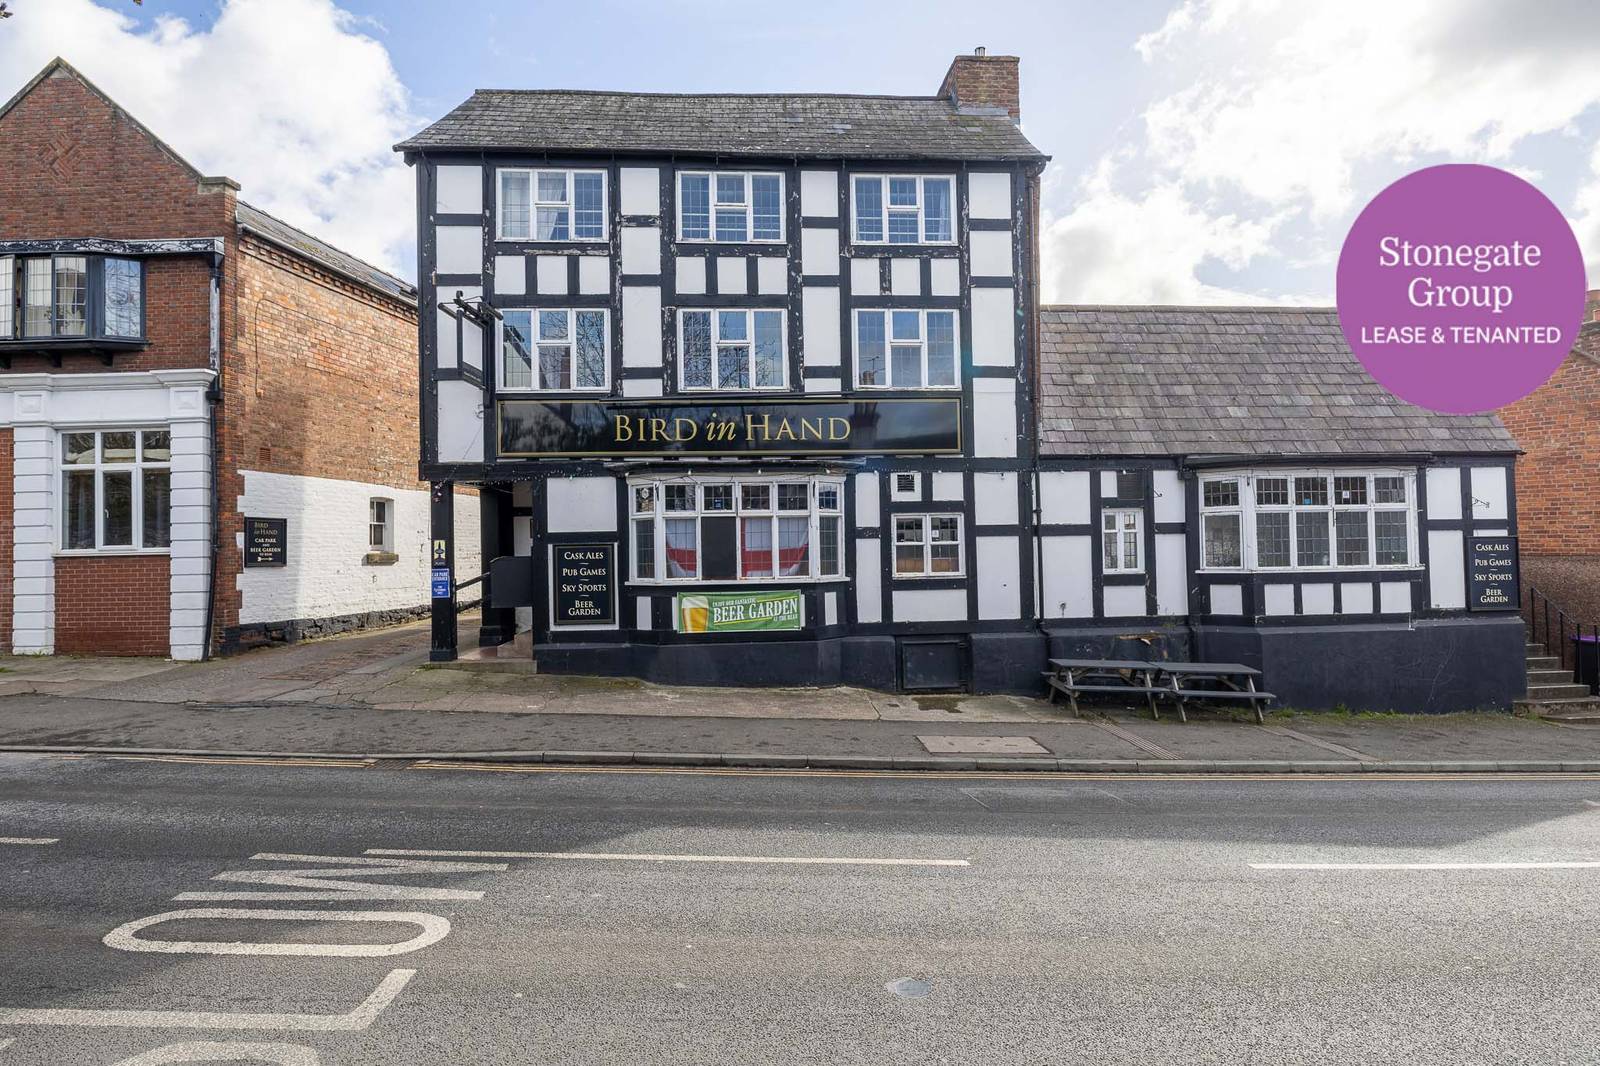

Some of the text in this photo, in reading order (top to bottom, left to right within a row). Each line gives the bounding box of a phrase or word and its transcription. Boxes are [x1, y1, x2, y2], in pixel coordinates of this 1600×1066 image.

[614, 412, 852, 442] BIRD in HAND
[1475, 543, 1510, 551] CASK ALES
[564, 551, 604, 560] CASK ALES
[1474, 559, 1488, 567] PUB
[562, 568, 606, 576] PUB GAMES
[1474, 573, 1512, 581] SKY SPORTS
[562, 584, 607, 592] SKY SPORTS
[1485, 588, 1502, 596] BEER
[575, 600, 594, 608] BEER
[568, 608, 601, 616] GARDEN
[713, 598, 798, 623] BEER GARDEN
